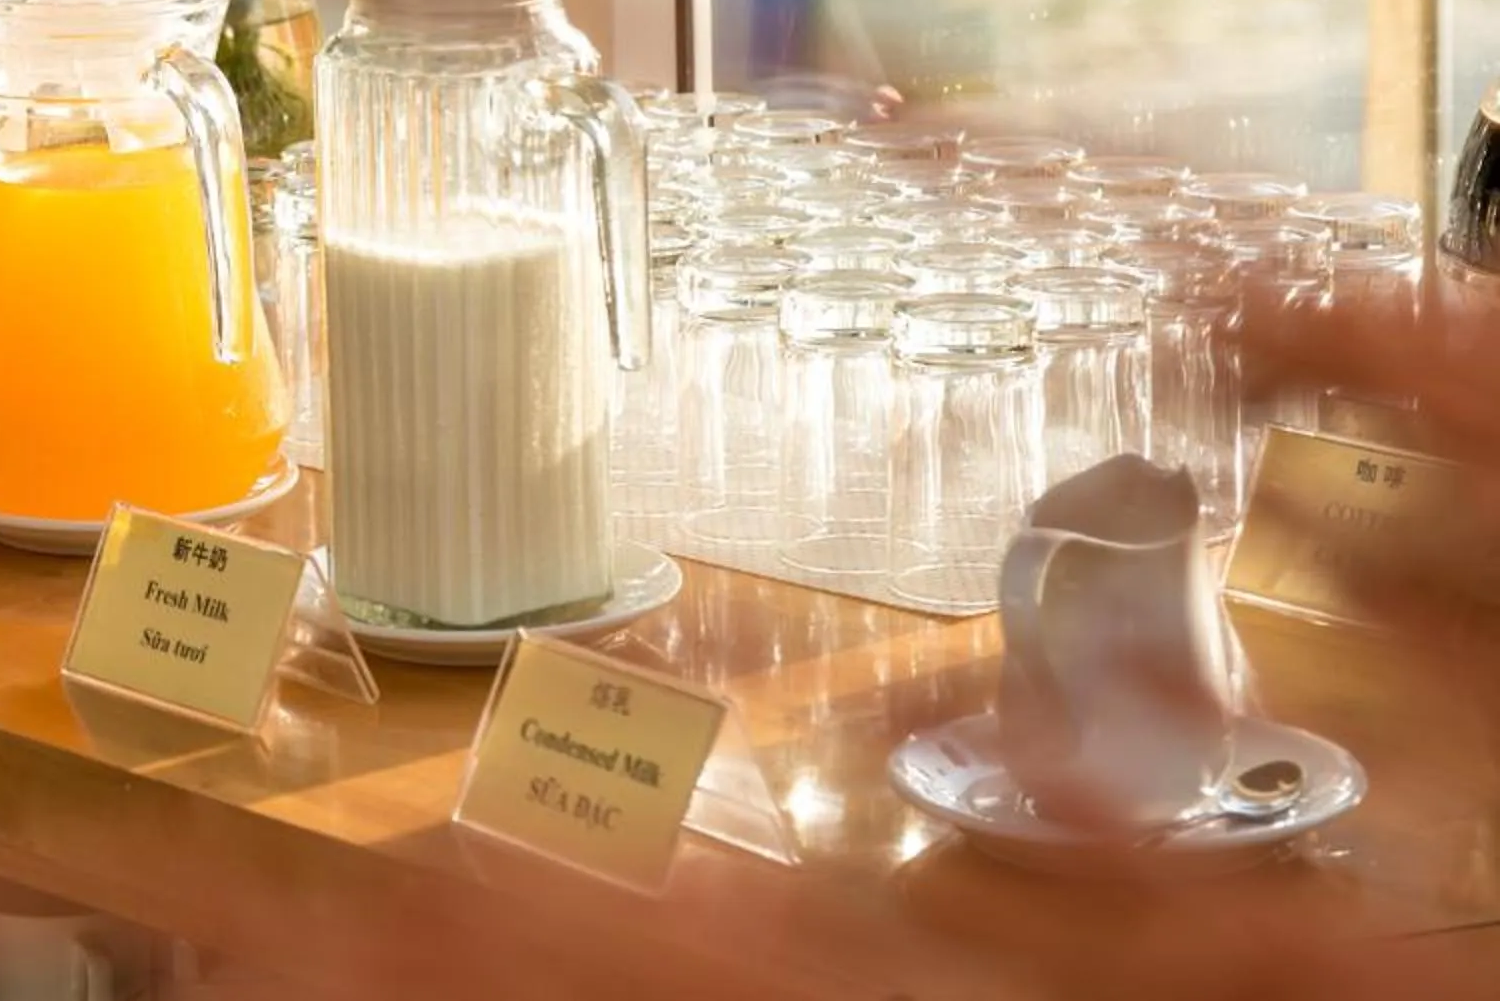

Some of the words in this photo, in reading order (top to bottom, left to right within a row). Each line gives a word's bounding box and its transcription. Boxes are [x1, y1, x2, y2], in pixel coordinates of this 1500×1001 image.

[144, 580, 190, 611] Fresh
[193, 593, 230, 623] Milk
[519, 717, 620, 773] Condensed
[622, 752, 665, 790] Milk
